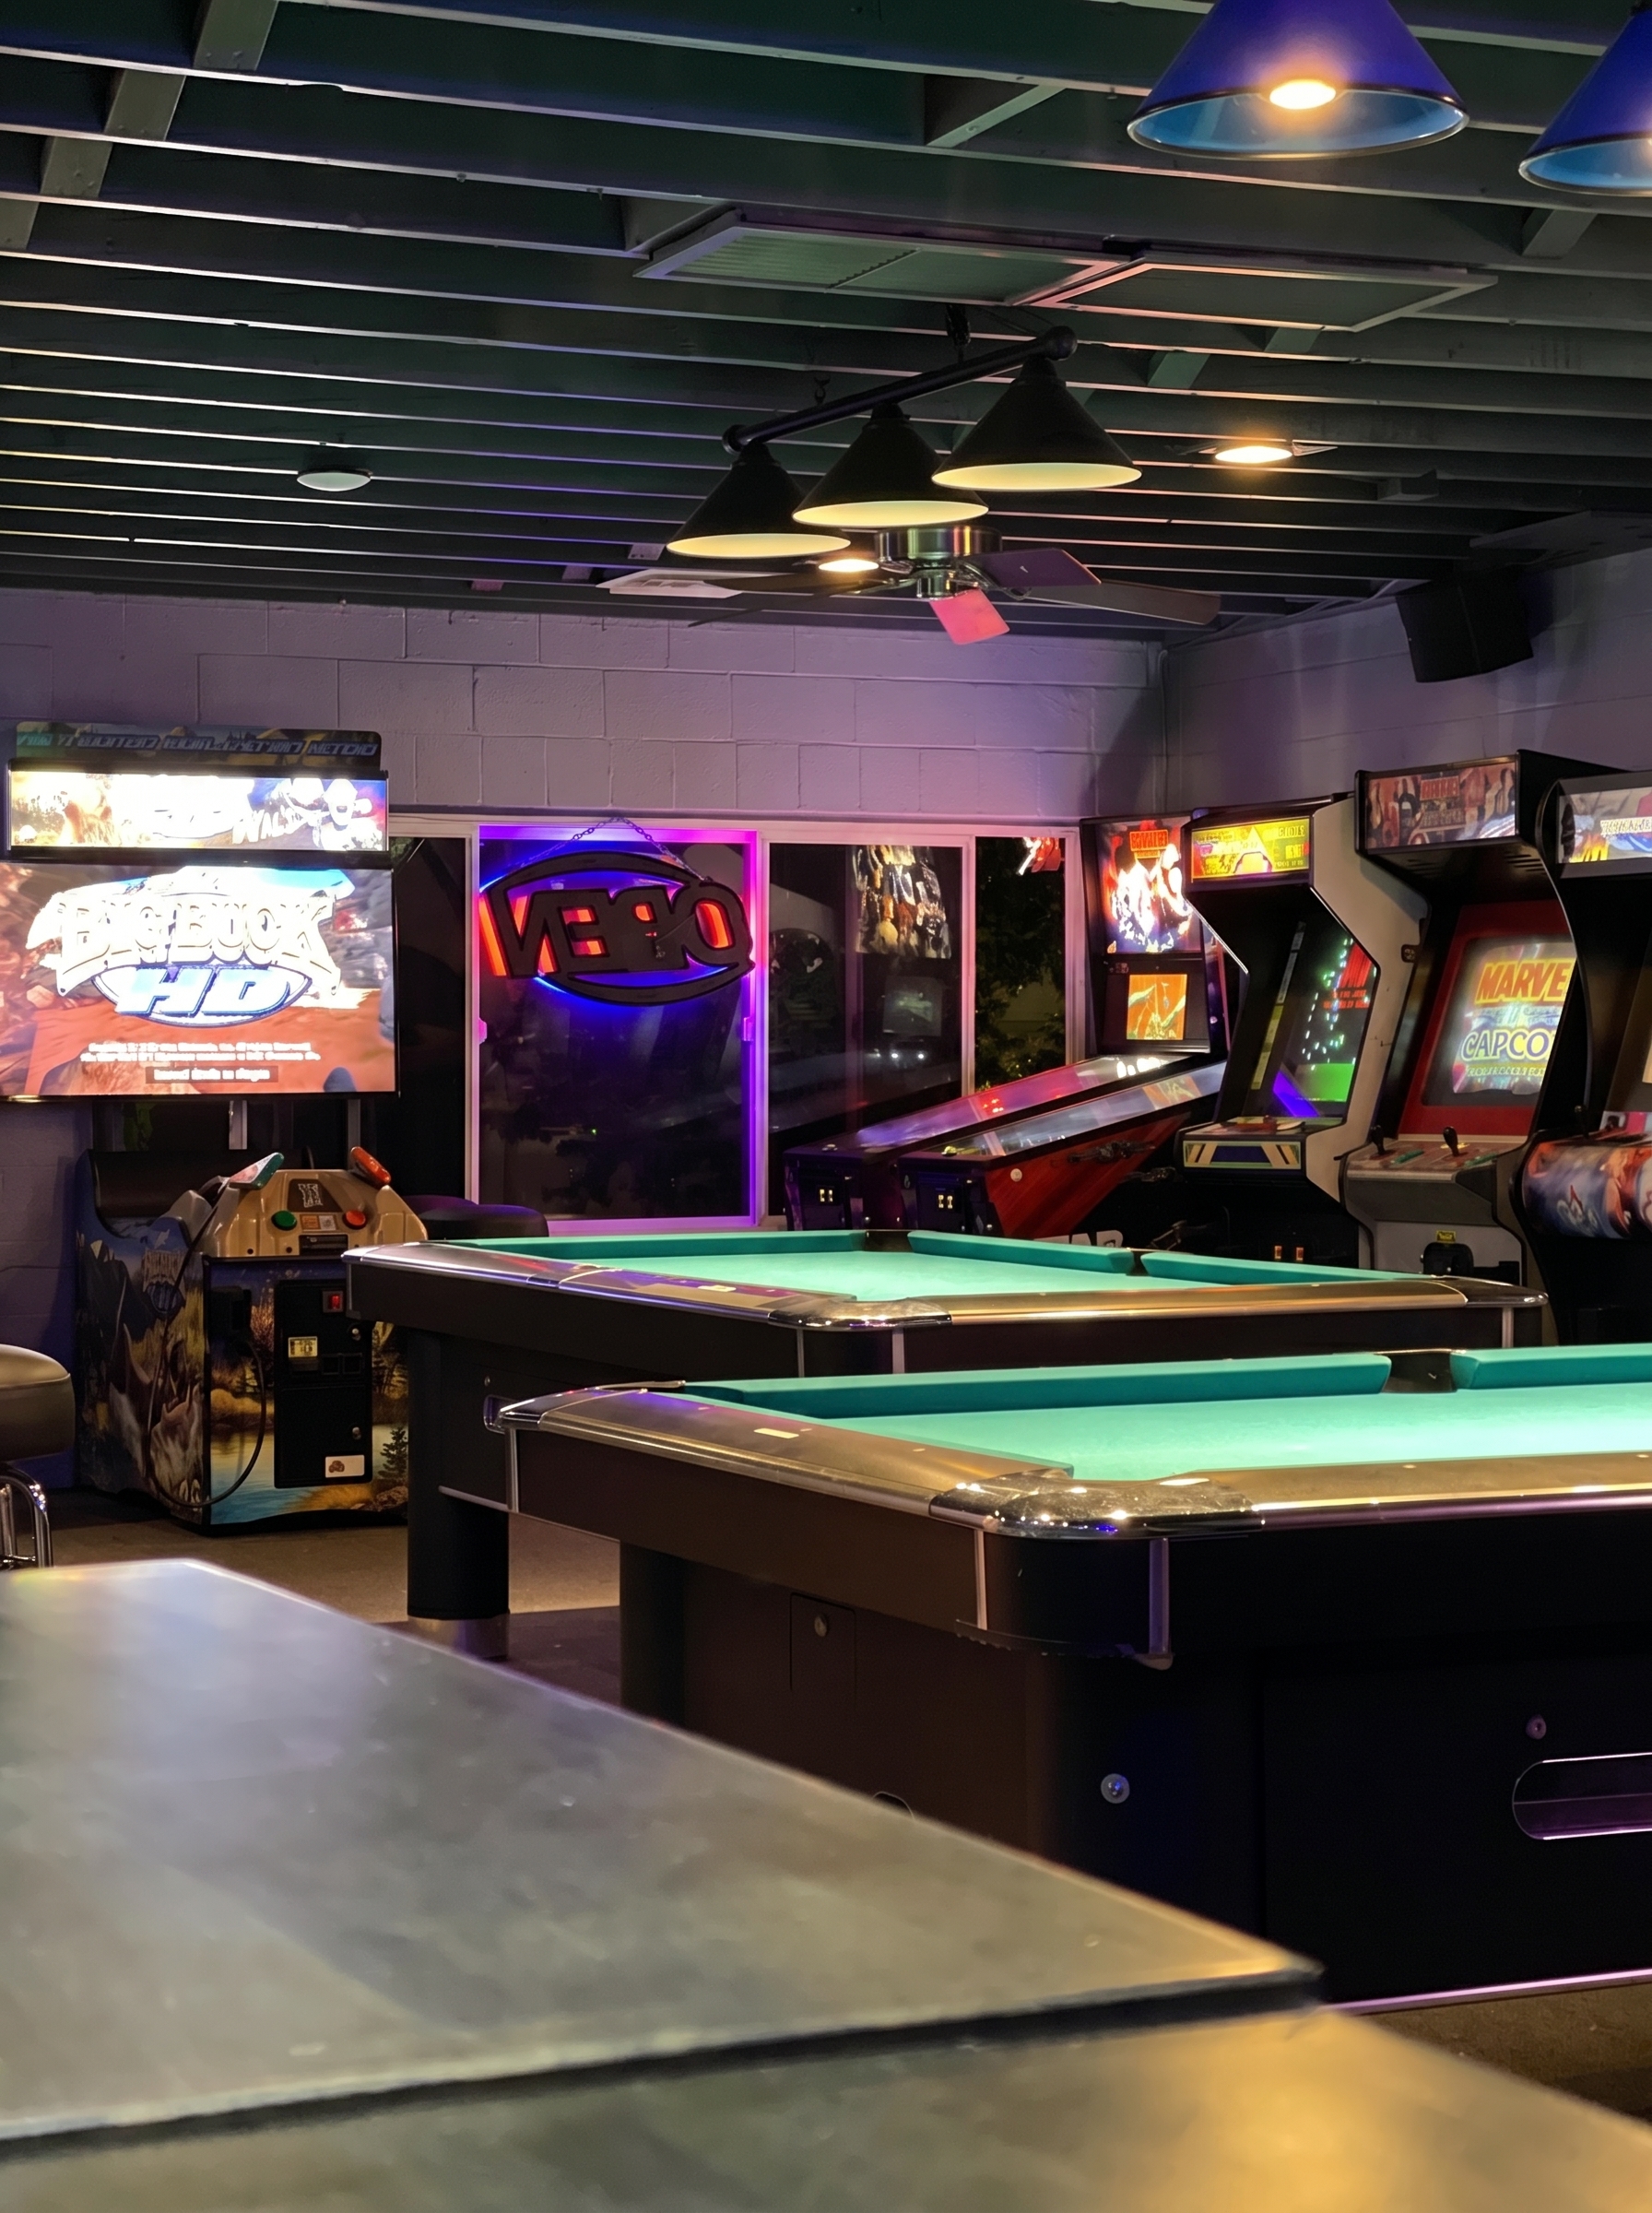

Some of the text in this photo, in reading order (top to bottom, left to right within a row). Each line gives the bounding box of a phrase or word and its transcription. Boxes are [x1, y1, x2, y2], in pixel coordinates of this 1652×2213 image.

[116, 967, 290, 1017] HD
[1475, 959, 1575, 1003] MARVE
[1461, 1028, 1556, 1061] CAPCO
